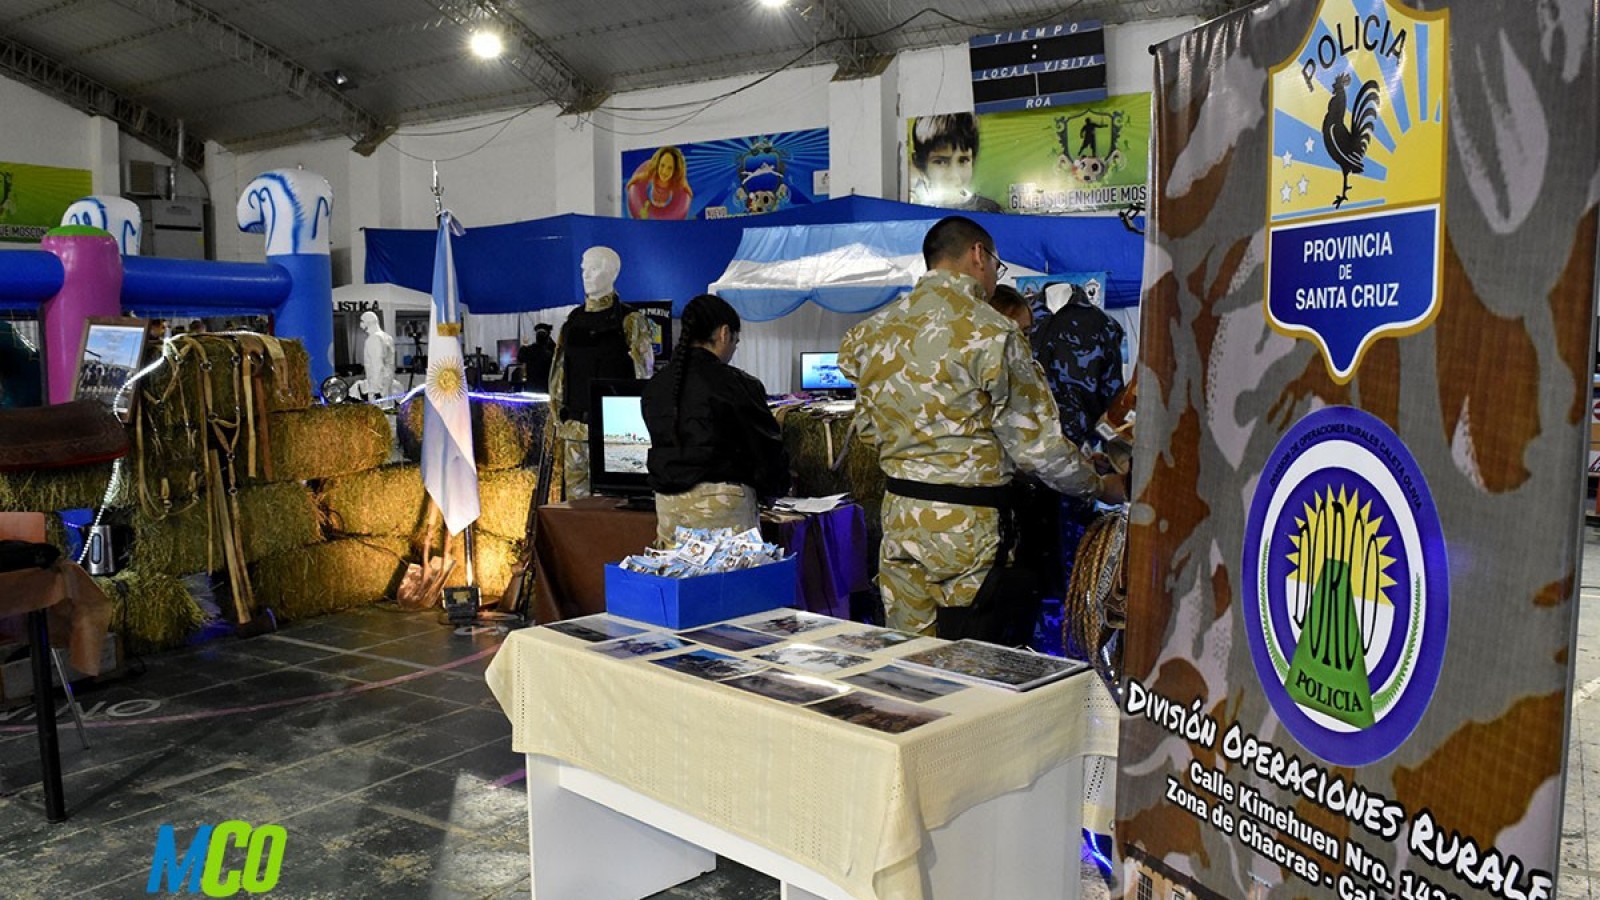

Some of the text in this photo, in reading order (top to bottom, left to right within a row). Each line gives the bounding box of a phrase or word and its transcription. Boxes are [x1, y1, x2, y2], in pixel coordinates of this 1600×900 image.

[994, 22, 1079, 44] TIEMPO
[981, 56, 1097, 80] LOCAL VISITA
[1301, 15, 1407, 92] POLICIA
[1025, 98, 1052, 109] ROA
[1069, 187, 1117, 205] ENRIQUE
[1303, 231, 1393, 263] PROVINCIA
[1338, 264, 1352, 280] DE
[1295, 283, 1400, 310] SANTA CRUZ
[1347, 424, 1380, 447] RURALES
[1380, 442, 1405, 477] CALETA
[1403, 475, 1422, 509] OLIVIA
[1295, 668, 1363, 713] POLICIA
[1127, 681, 1553, 900] DIVISIÓN OPERACIONES RURALE
[1166, 778, 1208, 819] Zona
[1212, 805, 1234, 832] de
[1239, 819, 1320, 882] Chacras
[1190, 761, 1234, 801] Calle
[1239, 786, 1339, 859] Kimehuen
[1345, 842, 1393, 890] Nro.
